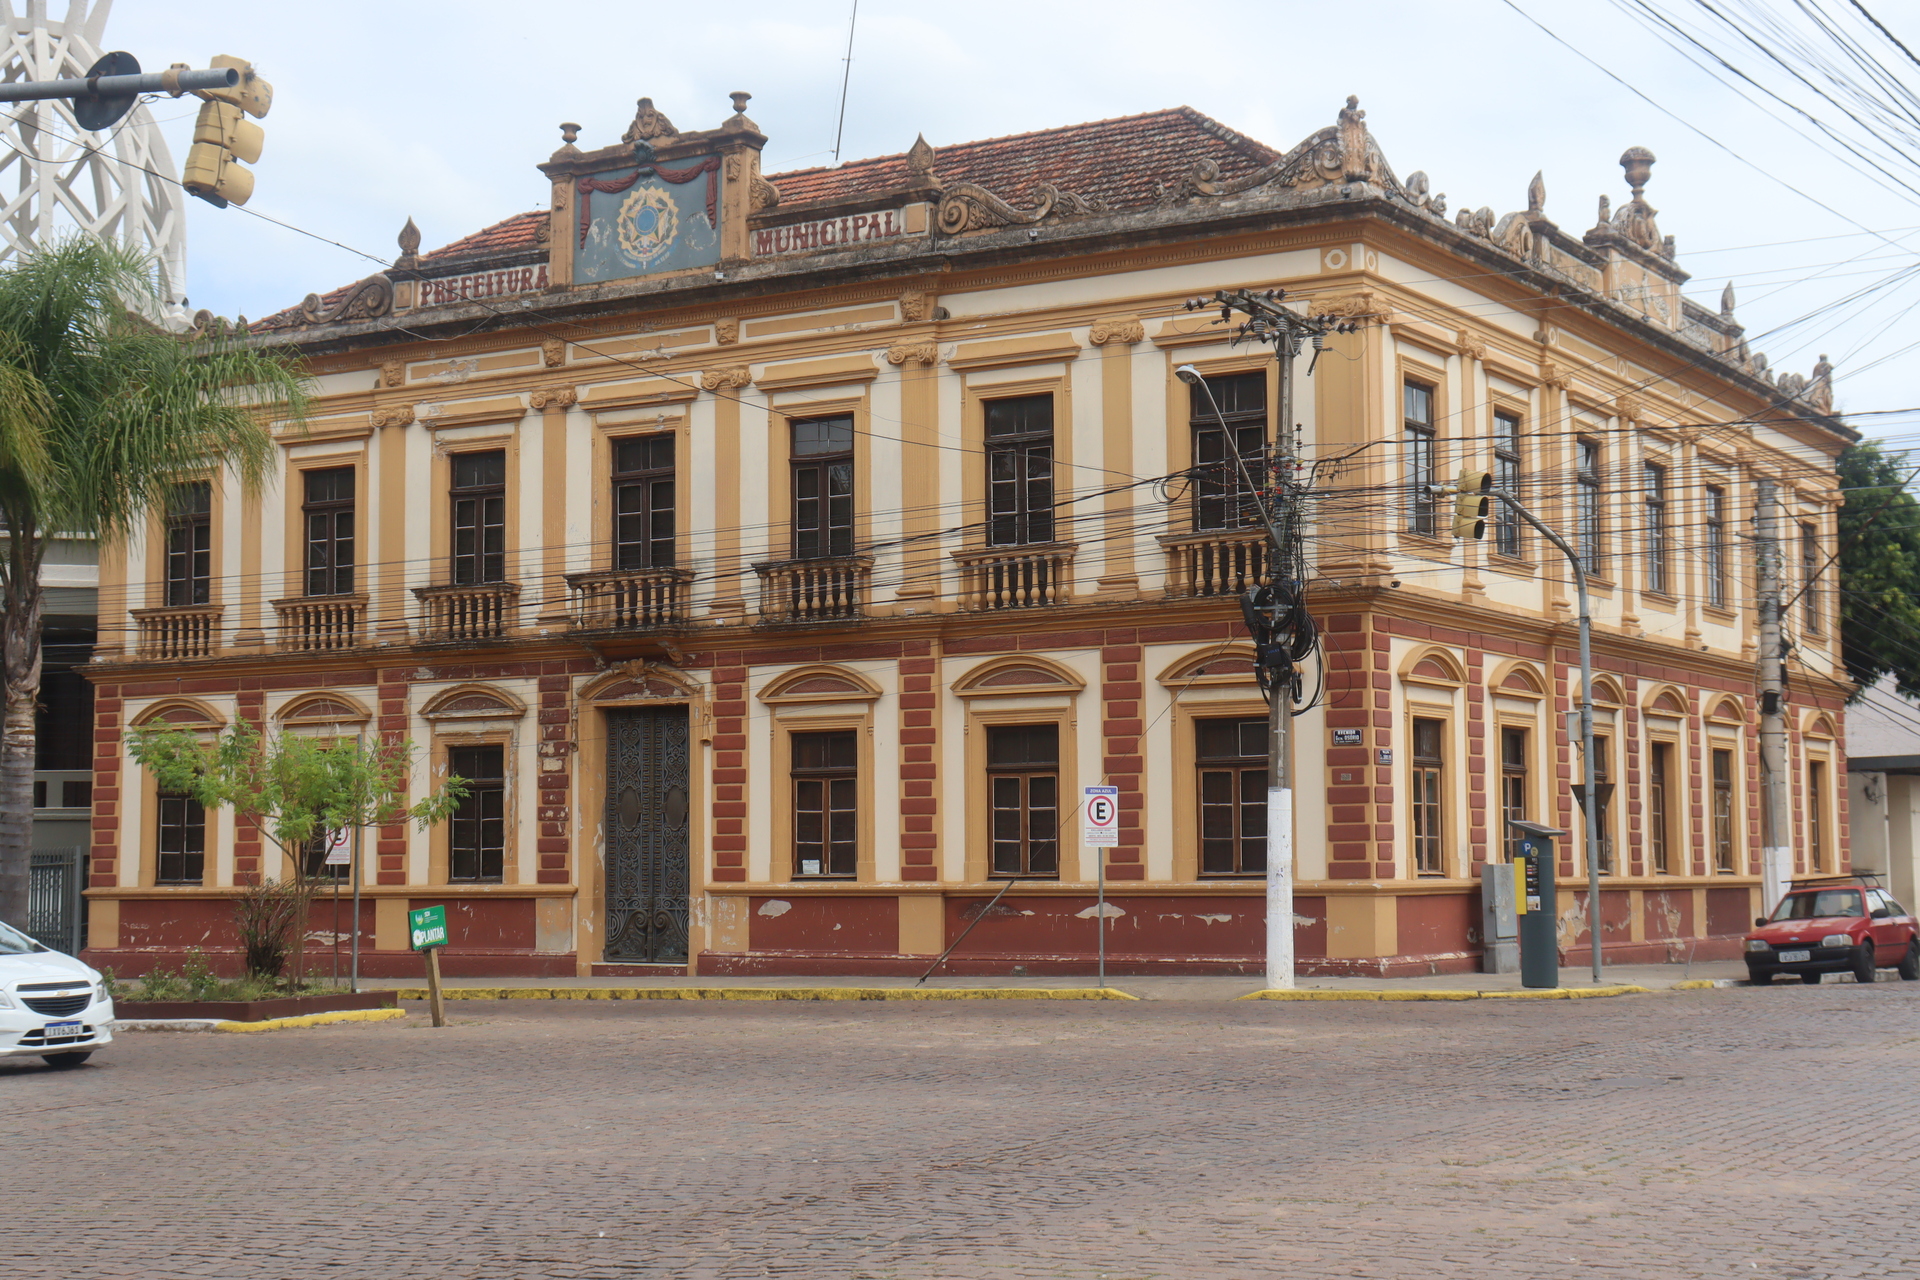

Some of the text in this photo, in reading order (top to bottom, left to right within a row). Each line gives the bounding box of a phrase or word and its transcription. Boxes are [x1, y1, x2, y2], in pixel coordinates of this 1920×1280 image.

[420, 211, 901, 306] PREFEITURA MUNICIPAL
[1096, 802, 1106, 820] E
[1524, 843, 1531, 852] P
